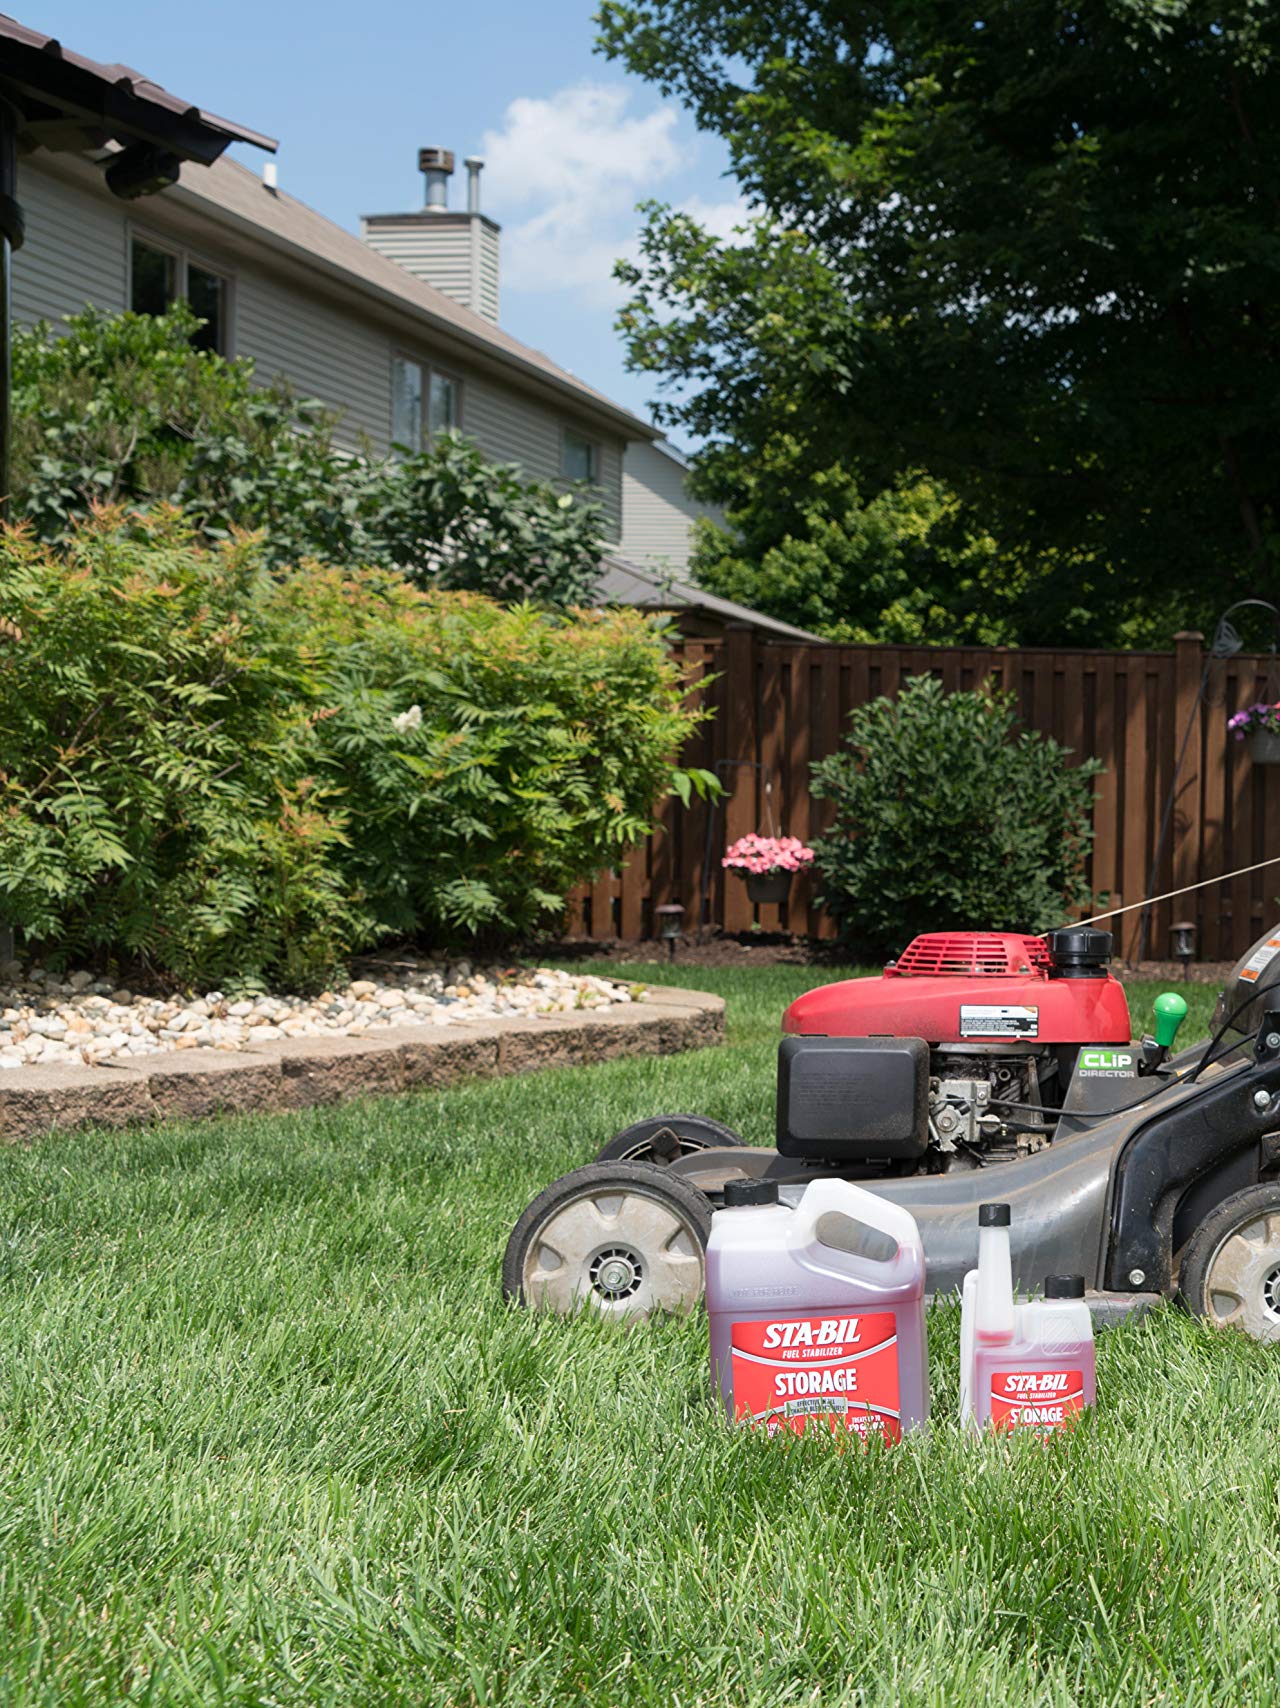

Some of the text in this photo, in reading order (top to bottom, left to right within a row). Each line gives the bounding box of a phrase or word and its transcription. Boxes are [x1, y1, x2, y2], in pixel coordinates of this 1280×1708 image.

[1079, 1069, 1135, 1078] DIRECTOR
[763, 1318, 862, 1348] STA-BIL
[782, 1347, 844, 1359] FUEL STABILIZER
[775, 1368, 858, 1396] STORAGE
[1004, 1374, 1069, 1392] STA-BIL
